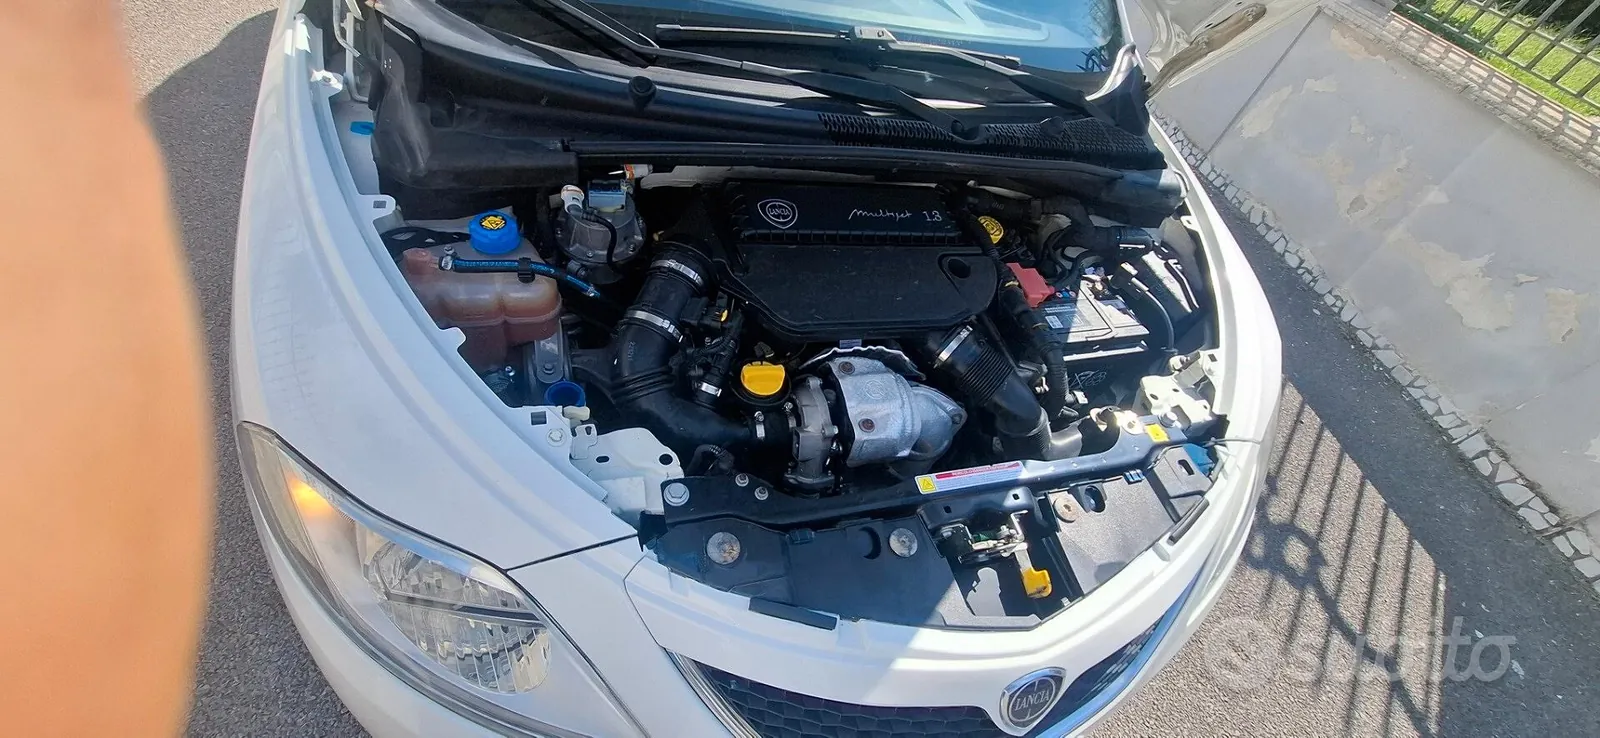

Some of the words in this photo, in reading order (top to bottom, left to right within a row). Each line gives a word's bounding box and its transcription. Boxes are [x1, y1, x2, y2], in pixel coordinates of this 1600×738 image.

[768, 207, 791, 216] LANCIA
[922, 210, 943, 222] 1.3
[1014, 689, 1050, 712] LANCIA
